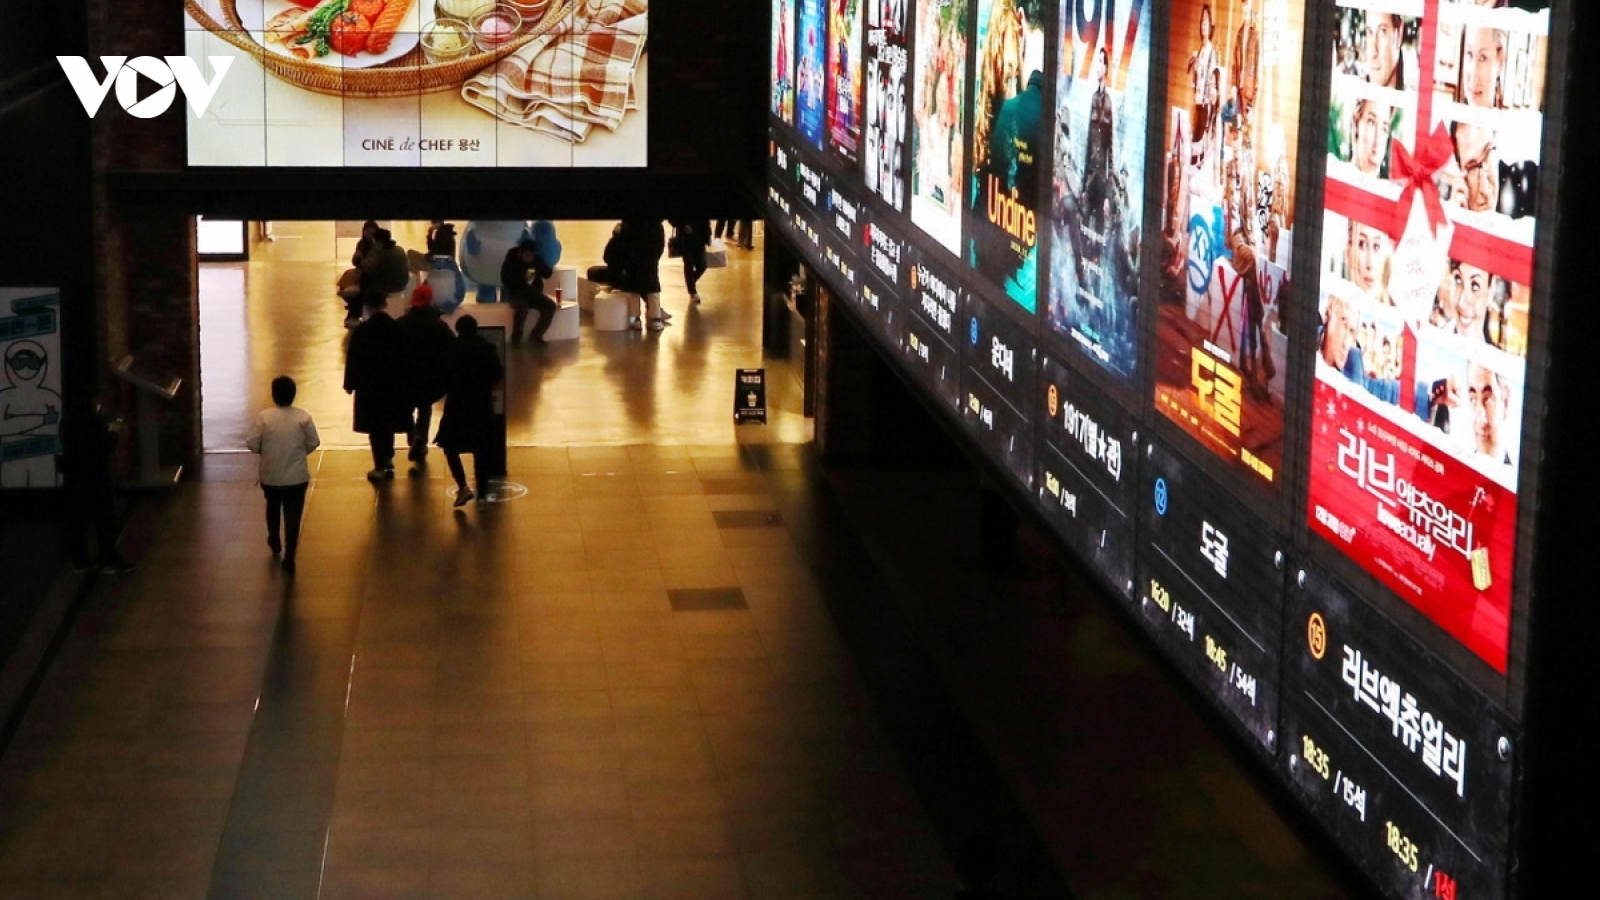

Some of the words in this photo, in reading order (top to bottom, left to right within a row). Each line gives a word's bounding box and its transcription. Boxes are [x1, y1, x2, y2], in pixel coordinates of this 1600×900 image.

[399, 136, 415, 151] de
[418, 138, 454, 151] CHEF
[458, 138, 480, 152] 용산
[987, 173, 1037, 247] Undine
[1191, 346, 1242, 438] 도굴
[1200, 520, 1229, 579] 도굴
[1303, 734, 1329, 780] 18:35
[1386, 821, 1418, 873] 18:35
